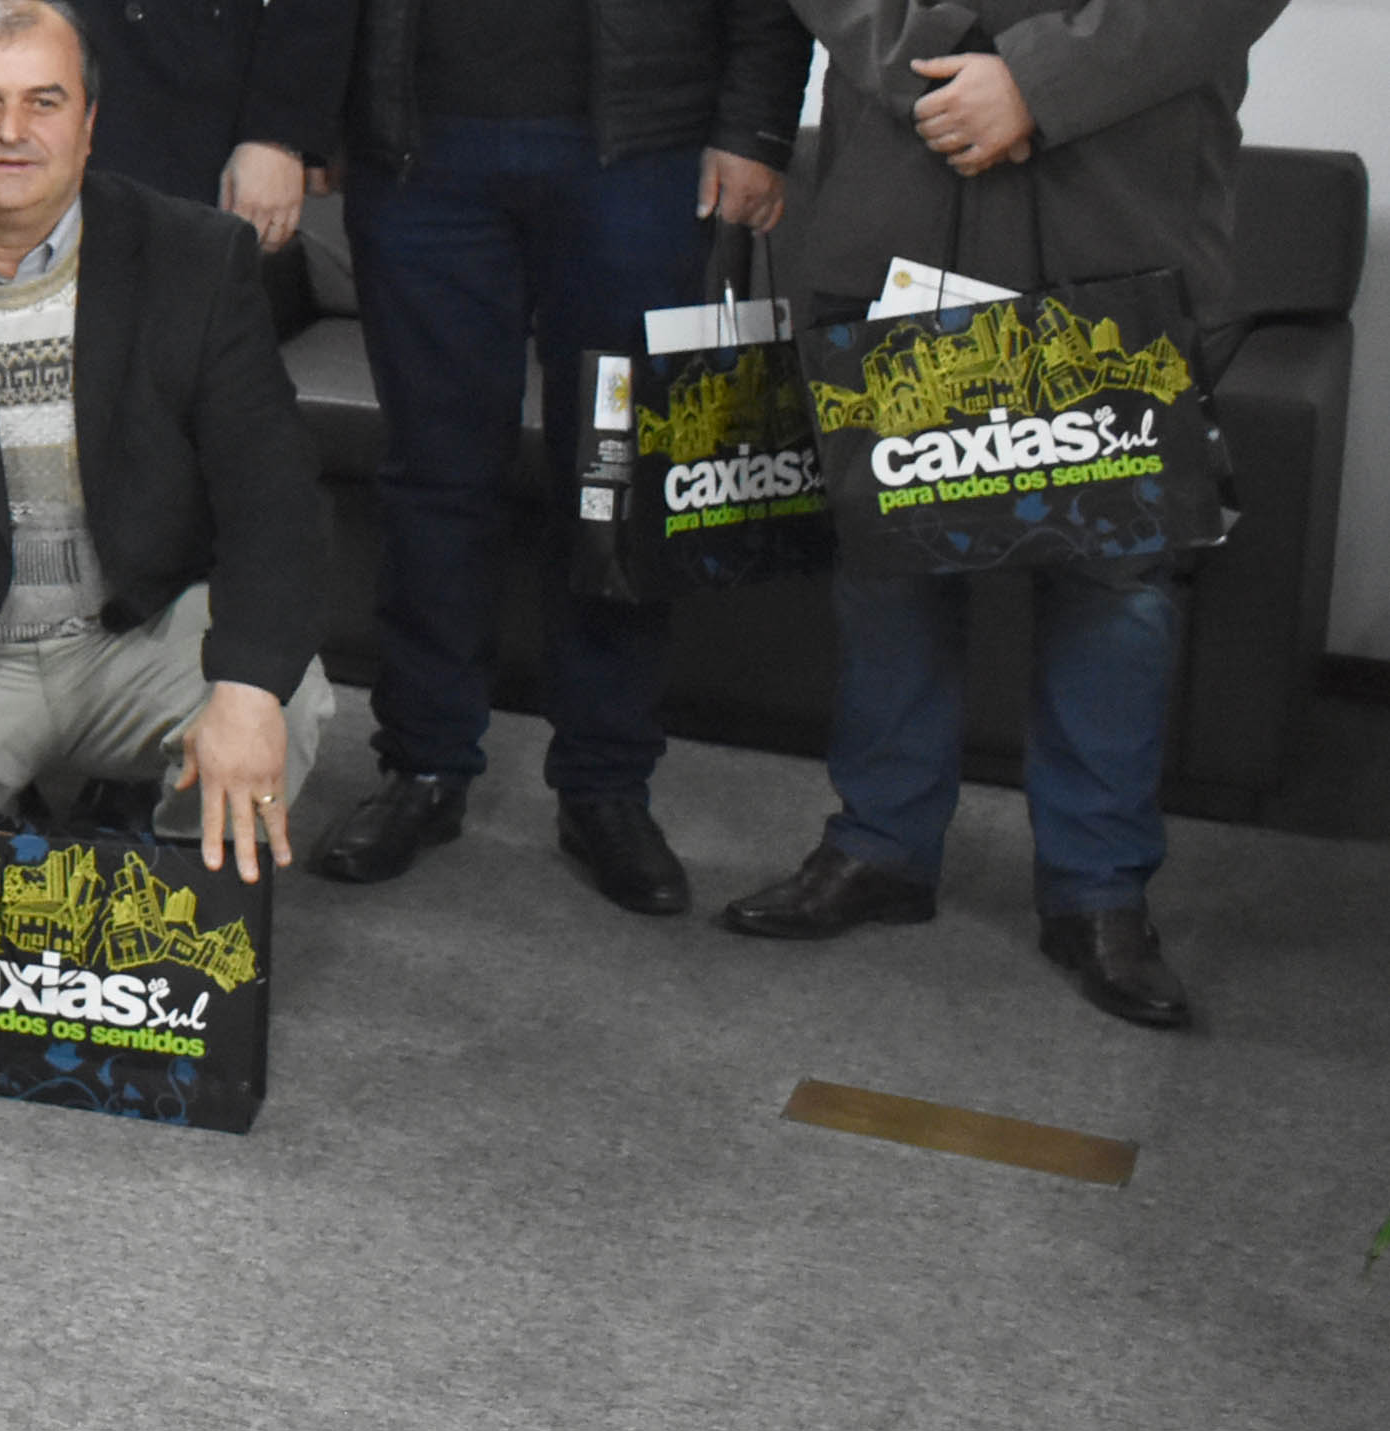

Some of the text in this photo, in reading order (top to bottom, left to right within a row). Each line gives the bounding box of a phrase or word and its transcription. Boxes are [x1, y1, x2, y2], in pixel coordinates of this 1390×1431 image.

[870, 407, 1099, 487] caxias
[1098, 408, 1158, 455] Sul
[664, 443, 802, 512] caxias
[878, 451, 1163, 515] para todos os sentidos
[665, 511, 701, 539] para
[702, 503, 746, 528] todos
[146, 989, 210, 1031] Sul
[52, 1017, 86, 1042] os
[90, 1023, 206, 1058] sentidos
